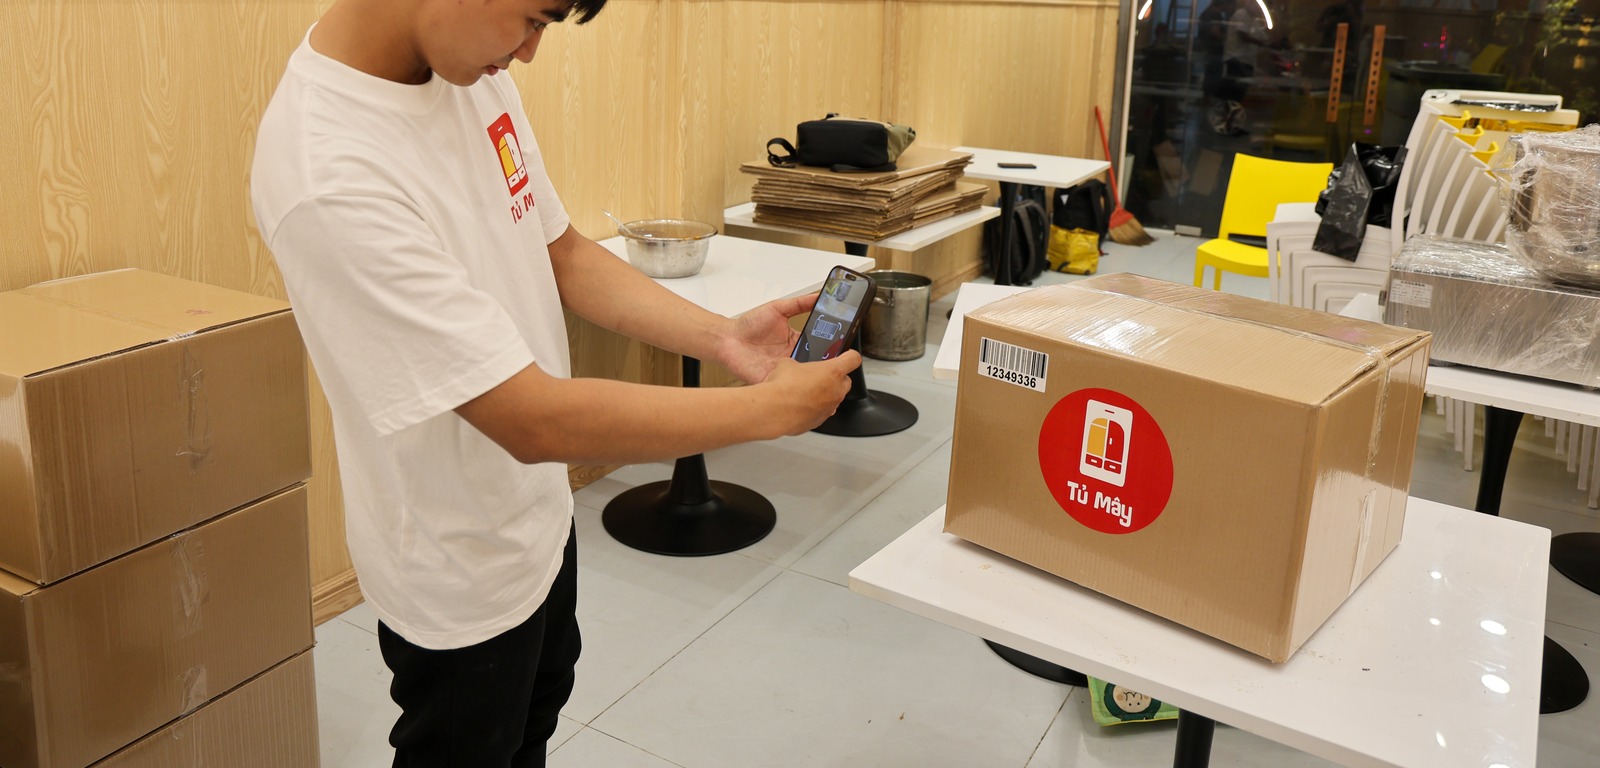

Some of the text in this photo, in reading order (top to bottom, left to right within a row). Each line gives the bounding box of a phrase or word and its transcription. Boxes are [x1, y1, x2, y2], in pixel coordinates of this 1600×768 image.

[986, 365, 1036, 388] 12349336
[1067, 480, 1132, 528] Tủ Mây
